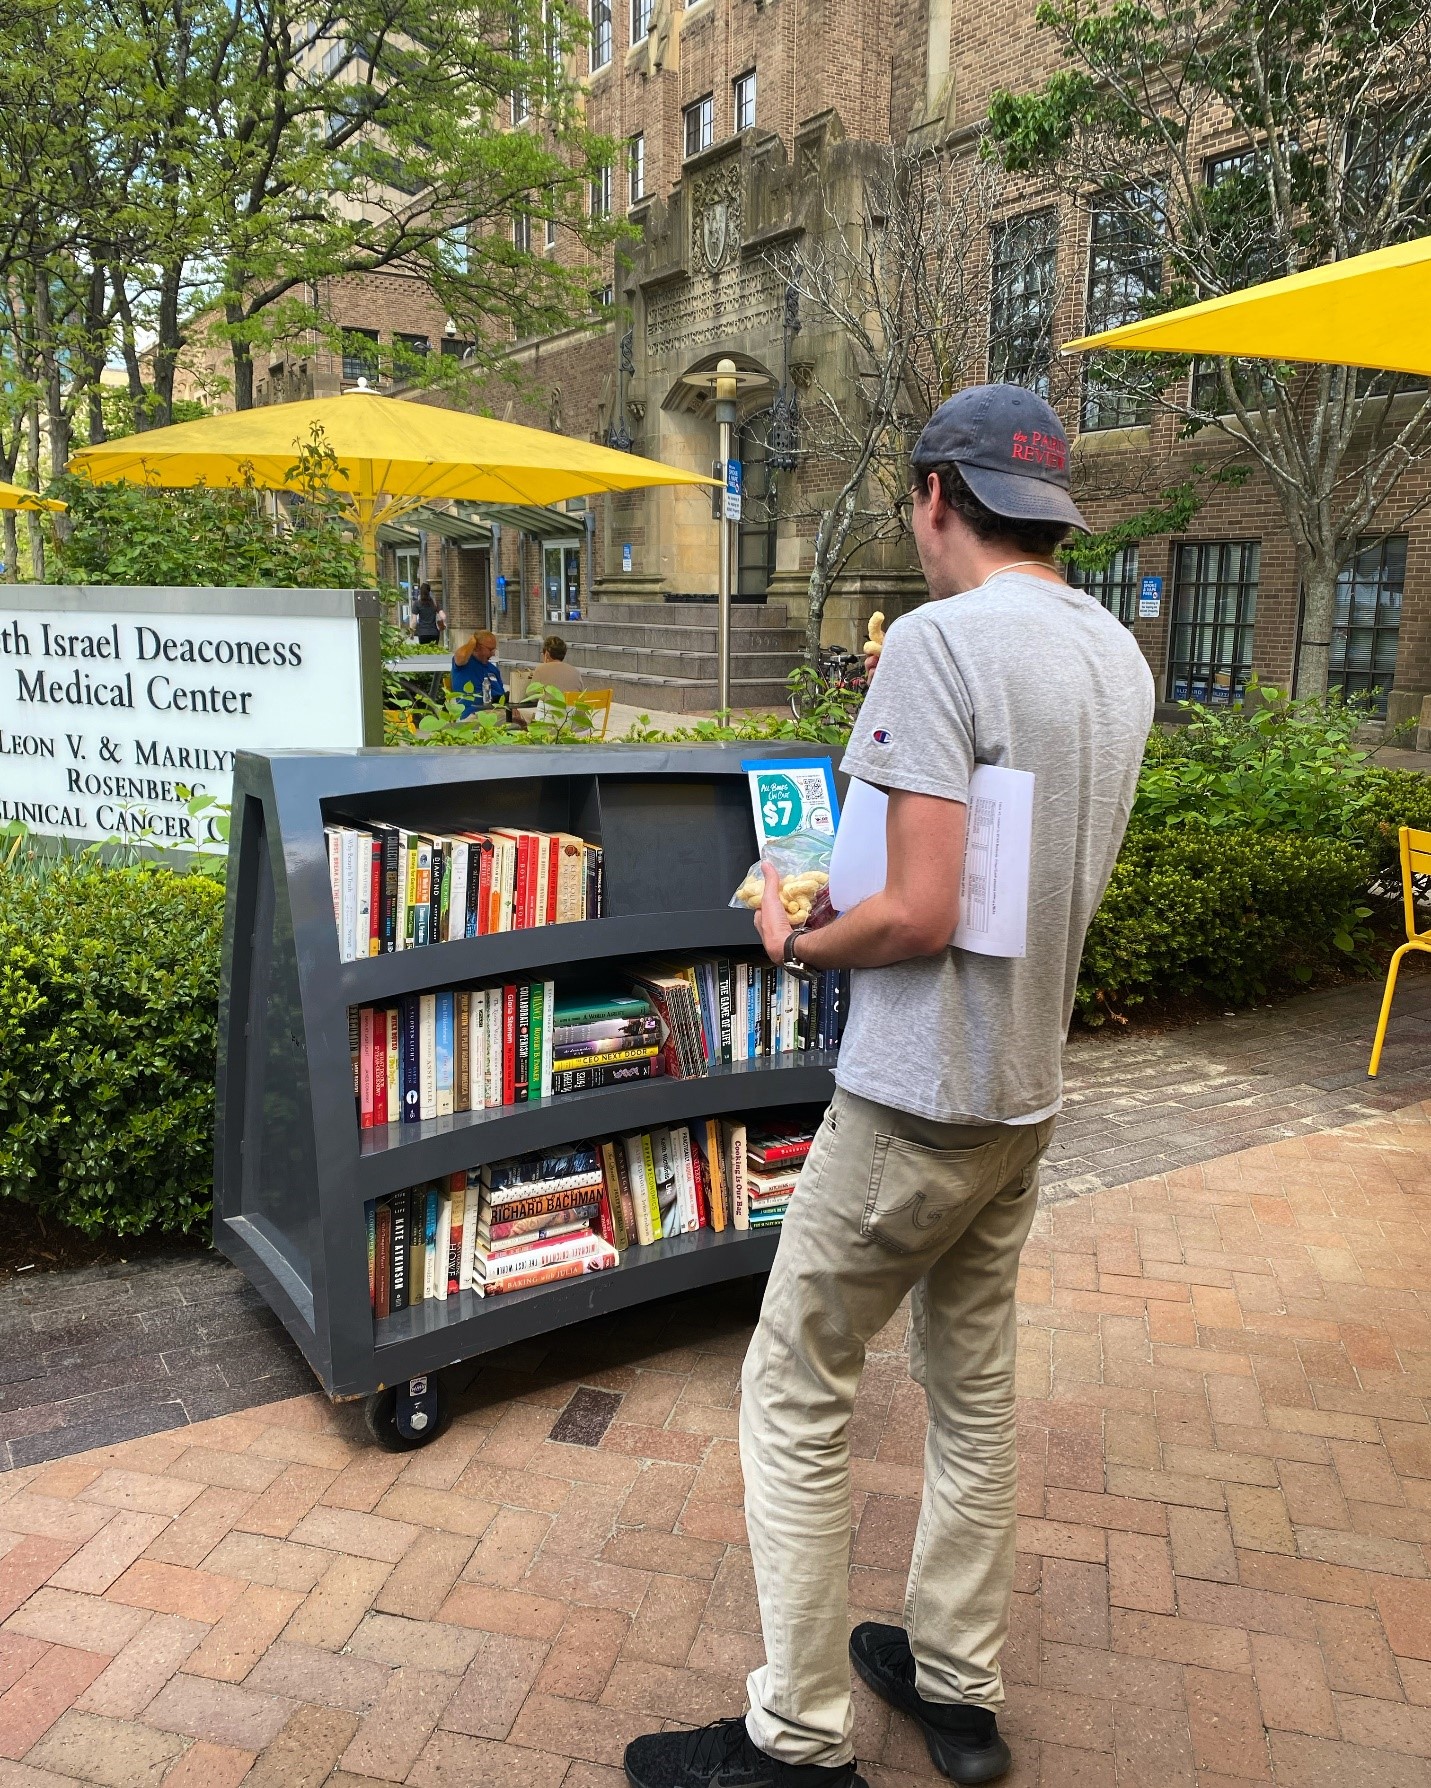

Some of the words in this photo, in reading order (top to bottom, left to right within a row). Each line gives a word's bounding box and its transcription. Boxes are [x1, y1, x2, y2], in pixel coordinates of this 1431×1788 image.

[1013, 431, 1027, 442] the
[41, 623, 121, 660] Israel
[134, 626, 302, 667] Deaconess
[16, 668, 134, 708] Medical
[147, 676, 252, 715] Center
[65, 734, 85, 759] V.
[99, 736, 122, 764] &
[0, 801, 87, 828] LINICAL
[96, 804, 193, 838] CANCER
[763, 801, 792, 827] $7
[386, 836, 398, 870] COLLECTIVE
[720, 980, 729, 996] THE
[520, 987, 528, 1027] COLLABORATE
[721, 997, 729, 1018] GAME
[349, 1008, 358, 1052] EXECUTION
[722, 1020, 730, 1028] OF
[722, 1030, 731, 1046] LIFE
[519, 1034, 528, 1058] PERISH!
[583, 1056, 599, 1064] CEO
[602, 1053, 621, 1061] NEXT
[625, 1049, 647, 1057] DOOR
[662, 1153, 670, 1179] Richards
[734, 1141, 742, 1174] Cooking
[618, 1152, 628, 1196] WARLIGHT
[491, 1201, 542, 1223] RICHARD
[547, 1188, 604, 1212] BACHMAN
[647, 1172, 657, 1211] ECONOMICS
[395, 1218, 403, 1241] KATE
[395, 1245, 403, 1290] ATKINSON
[448, 1243, 456, 1277] HOWE
[507, 1277, 538, 1289] BAKING
[540, 1273, 555, 1281] with
[556, 1267, 578, 1277] JULIA
